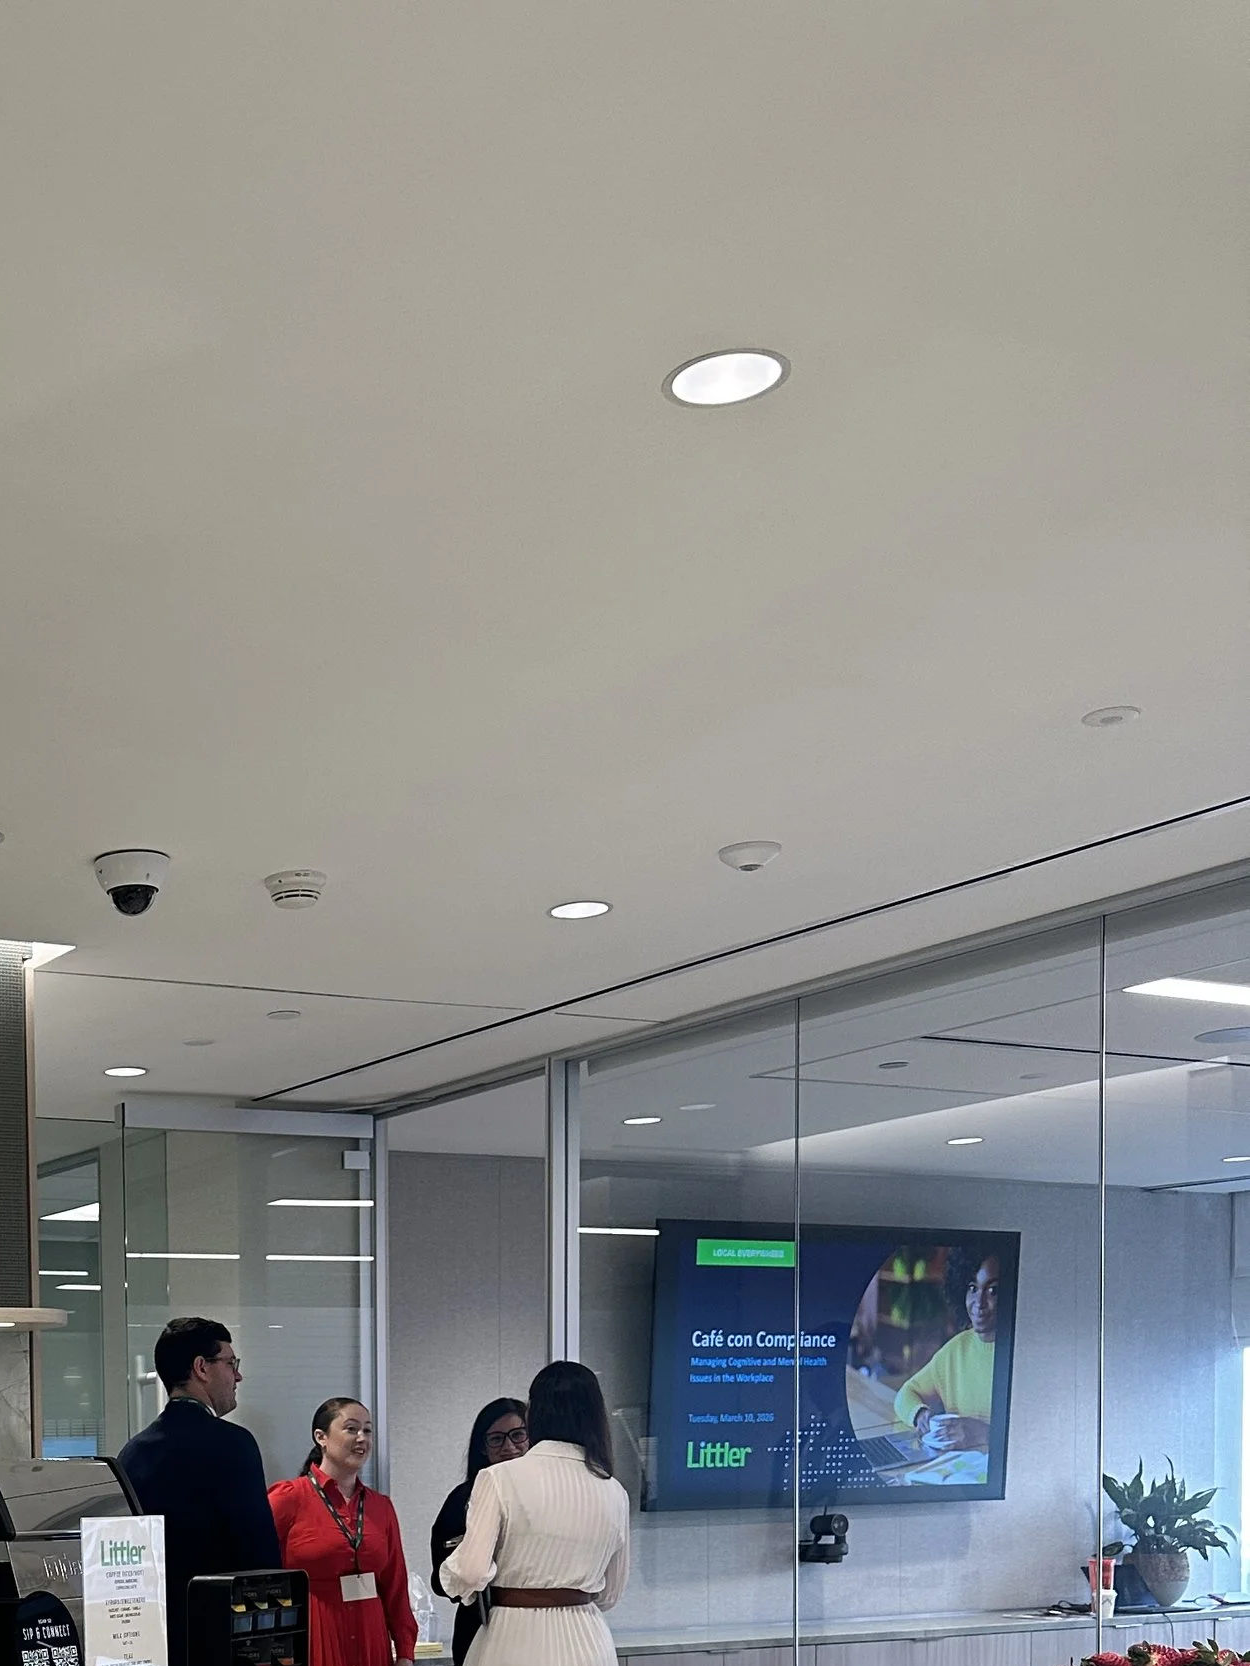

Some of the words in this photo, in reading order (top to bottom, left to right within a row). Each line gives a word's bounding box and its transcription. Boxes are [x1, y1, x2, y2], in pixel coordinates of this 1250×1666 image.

[692, 1330, 724, 1348] Café
[727, 1334, 752, 1348] con
[756, 1331, 836, 1350] Compiance
[691, 1357, 727, 1368] Managing
[728, 1357, 761, 1368] Cognitive
[763, 1357, 776, 1366] and
[778, 1357, 802, 1366] Menl
[803, 1357, 827, 1366] Health
[690, 1374, 712, 1383] Issues
[714, 1374, 721, 1382] in
[723, 1374, 735, 1382] the
[736, 1374, 774, 1383] Workplace
[688, 1414, 718, 1424] Tuesday,
[720, 1413, 743, 1422] March
[687, 1441, 752, 1468] Littler
[101, 1540, 146, 1566] Littler
[22, 1627, 33, 1640] SIP
[42, 1624, 70, 1639] CONNECT
